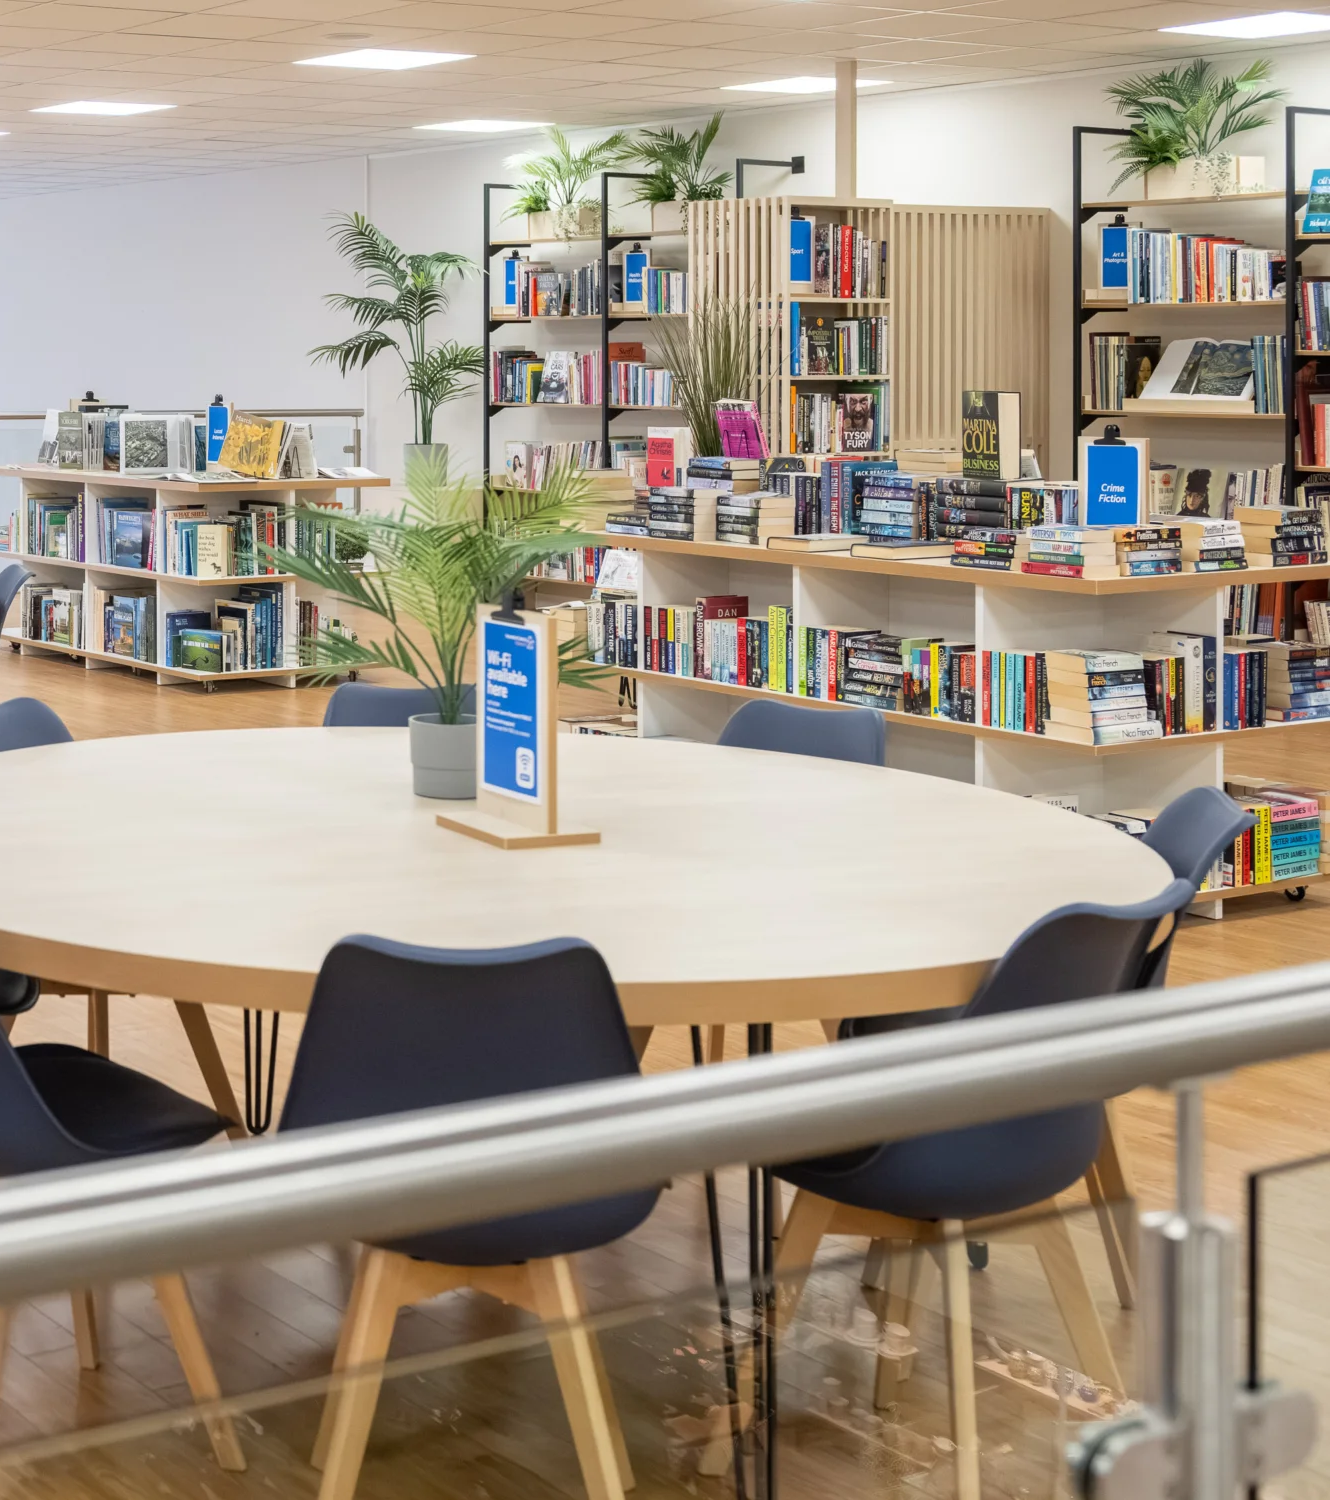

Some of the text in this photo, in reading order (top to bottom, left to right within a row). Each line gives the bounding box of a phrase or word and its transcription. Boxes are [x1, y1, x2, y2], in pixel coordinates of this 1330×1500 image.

[235, 414, 253, 424] March
[963, 418, 997, 433] MARTINA
[844, 431, 871, 440] TYSON
[651, 441, 672, 449] Agatha
[846, 439, 869, 448] FURY
[963, 430, 998, 455] COLE
[963, 458, 999, 471] BUSINESS
[1100, 483, 1125, 493] Crime
[831, 466, 839, 532] LEE CHILD THE ENEMY
[1098, 494, 1127, 503] Fiction
[1021, 491, 1031, 519] BURN
[1031, 529, 1056, 539] PATTERSON
[1136, 532, 1158, 540] Patterson
[717, 609, 737, 617] DAN
[696, 605, 704, 651] DAN BROWN
[487, 649, 512, 668] Wi-Fi
[1102, 659, 1119, 667] French
[879, 664, 900, 672] AUTOPSY
[487, 667, 528, 687] available
[852, 672, 895, 683] Cornwell RED MIST
[487, 681, 508, 699] here
[845, 684, 864, 692] Cornwell
[1114, 712, 1142, 721] Nicci French
[1121, 727, 1154, 738] Nicci French
[1272, 806, 1306, 819] PETER JAMES
[1271, 821, 1308, 833] PETER JAMES
[1271, 834, 1308, 847] PETER JAMES
[1273, 849, 1307, 862] PETER JAMES
[1274, 864, 1307, 877] PETER JAMES
